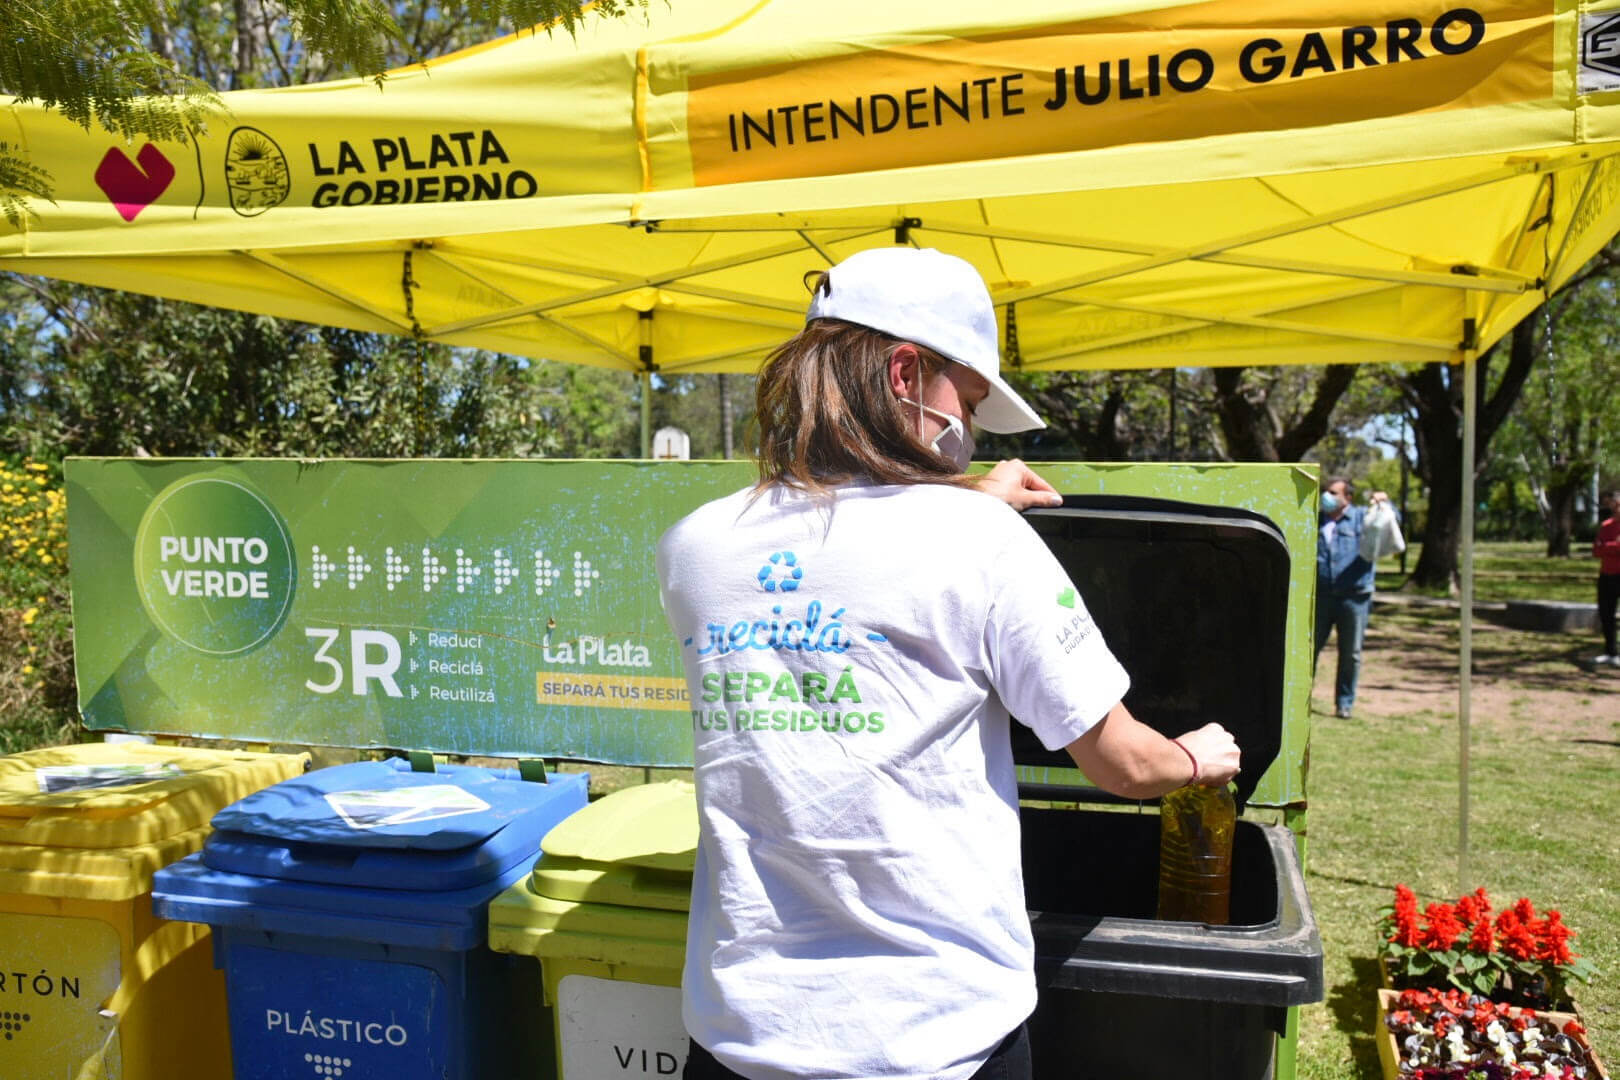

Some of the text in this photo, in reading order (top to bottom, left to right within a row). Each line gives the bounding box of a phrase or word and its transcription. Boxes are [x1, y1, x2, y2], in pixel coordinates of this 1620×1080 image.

[729, 8, 1486, 152] INTENDENTE JULIO GARRO
[308, 129, 510, 176] LA PLATA
[311, 169, 538, 208] GOBIERNO
[160, 536, 269, 564] PUNTO
[160, 570, 269, 598] VERDE
[305, 627, 404, 698] 3R
[543, 633, 652, 667] La Plata
[543, 681, 690, 702] SEPARÁ TUS RESID
[702, 664, 863, 704] SEPARÁ
[735, 709, 885, 733] RESIDUOS
[266, 1009, 407, 1046] PLÁSTICO
[613, 1045, 679, 1075] VID
